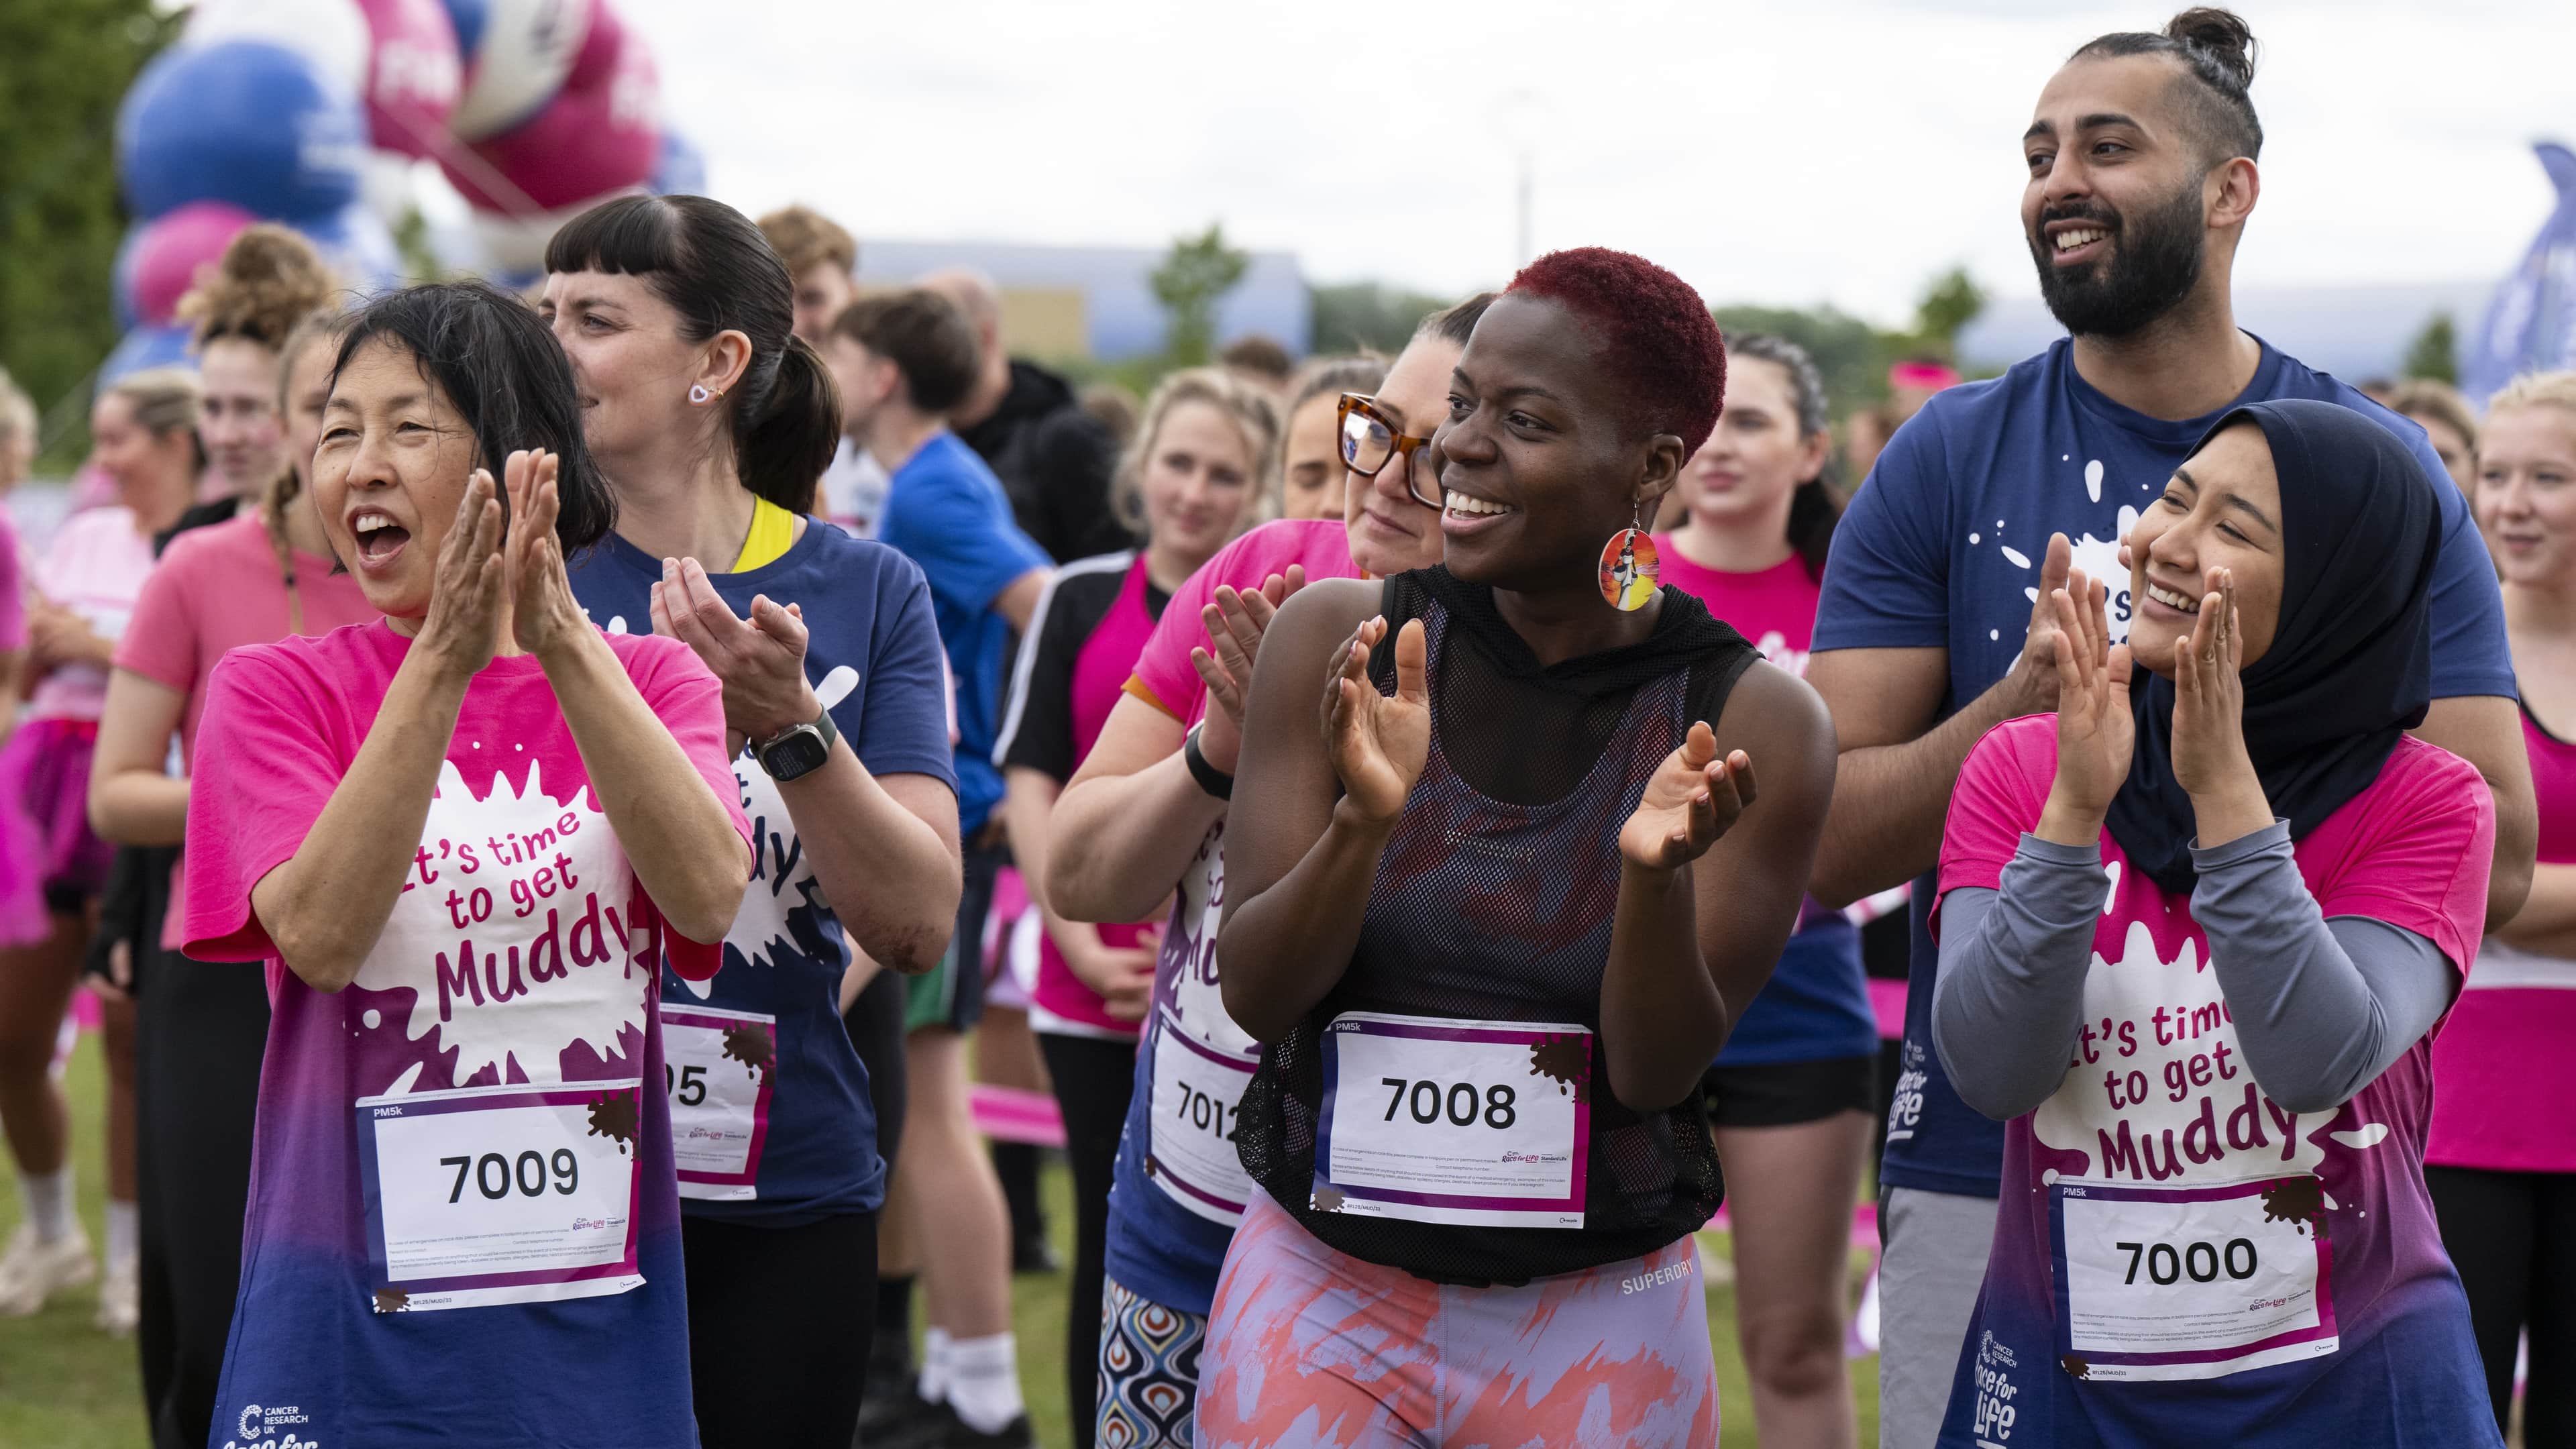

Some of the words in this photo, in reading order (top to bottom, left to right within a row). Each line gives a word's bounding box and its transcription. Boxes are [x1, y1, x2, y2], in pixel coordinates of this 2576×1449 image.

[400, 839, 480, 893] t's
[487, 812, 580, 866] time
[445, 888, 493, 929] to
[510, 852, 579, 918] get
[435, 892, 631, 1022] Muddy
[1336, 1022, 1361, 1032] PM5k
[2070, 1018, 2137, 1067] t's
[2104, 1070, 2148, 1110] to
[2164, 1040, 2237, 1102] get
[374, 1106, 403, 1118] PM5k
[1382, 1077, 1516, 1130] 7008
[2098, 1081, 2299, 1181] Muddy
[1501, 1155, 1517, 1164] Race
[440, 1148, 578, 1204] 7009
[2063, 1187, 2086, 1197] PM5k
[1621, 1258, 1694, 1295] SUPERDRY
[2116, 1238, 2257, 1285] 7000
[2249, 1303, 2265, 1311] Race
[1992, 1341, 2013, 1358] CANCER
[1992, 1349, 2017, 1368] RESEARCH
[1994, 1373, 2017, 1400] for
[264, 1406, 299, 1415] CANCER
[264, 1415, 309, 1425] RESEARCH
[1974, 1390, 2016, 1440] Life
[264, 1425, 275, 1434] UK
